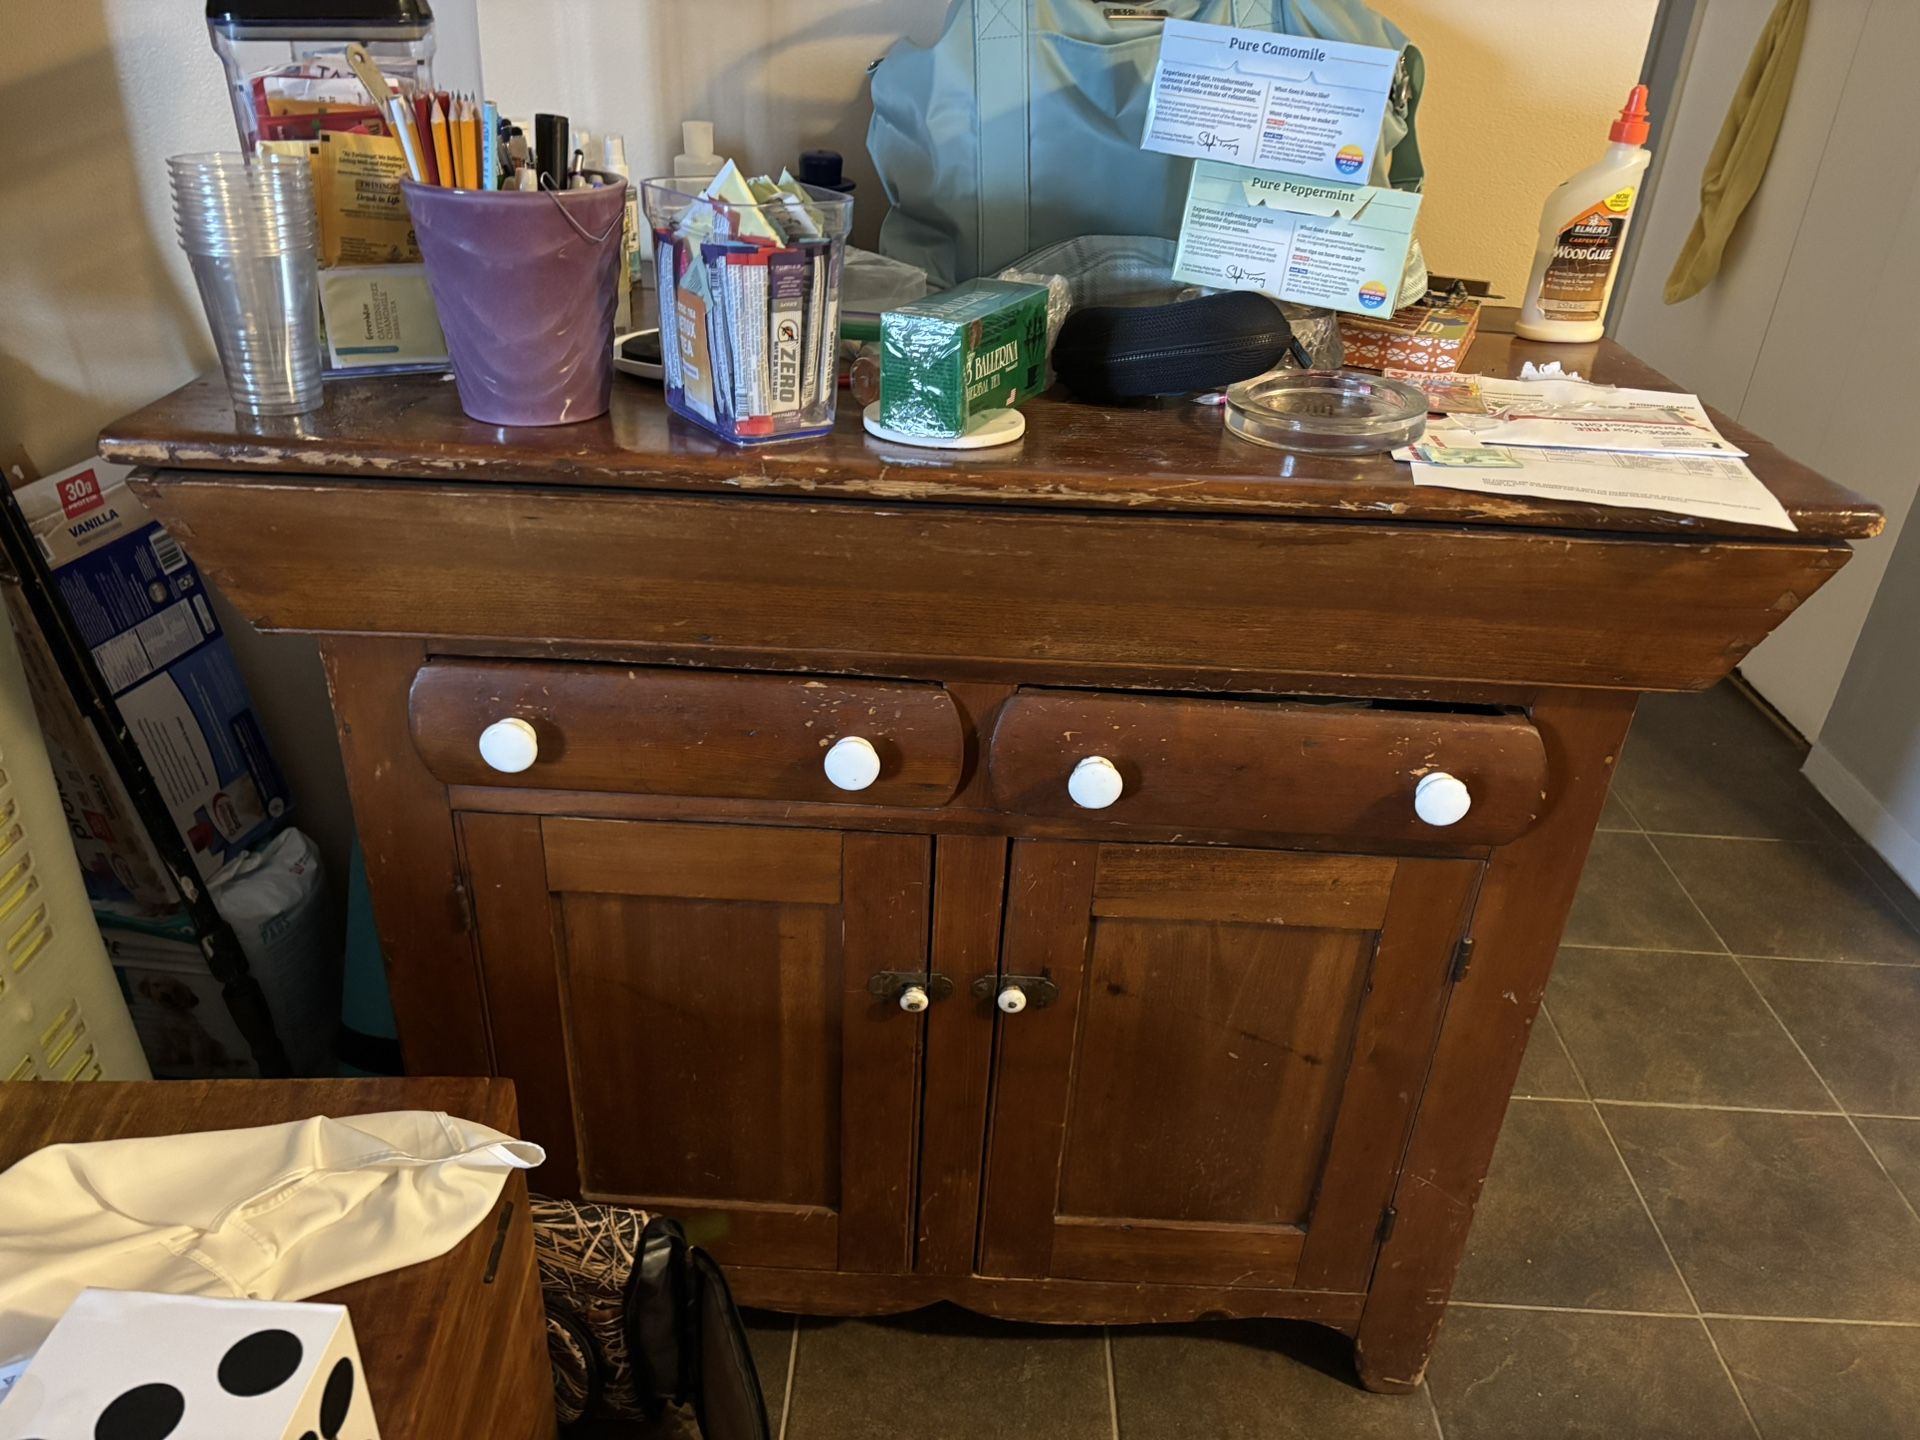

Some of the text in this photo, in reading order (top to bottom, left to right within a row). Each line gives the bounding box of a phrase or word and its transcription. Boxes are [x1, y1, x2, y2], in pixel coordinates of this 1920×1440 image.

[1229, 37, 1326, 62] Pure Camomile
[1160, 76, 1183, 85] moment
[1219, 84, 1232, 92] slow
[1246, 88, 1261, 96] mind
[1162, 68, 1191, 78] Experience
[1211, 76, 1253, 87] transformative
[1170, 84, 1182, 92] help
[1221, 91, 1228, 99] of
[1273, 85, 1287, 93] What
[1251, 177, 1355, 203] Pure Peppermint
[1191, 205, 1220, 215] Experience
[1224, 211, 1252, 221] refreshing
[1251, 215, 1262, 223] cup
[1262, 217, 1274, 225] that
[1205, 214, 1222, 223] soothe
[1222, 217, 1246, 227] digestion
[1246, 221, 1257, 229] and
[1189, 219, 1218, 229] invigorates
[1218, 224, 1231, 232] your
[975, 340, 1018, 380] BALLERINA
[780, 347, 796, 403] ZERO
[1410, 373, 1471, 383] MAGNET
[65, 479, 93, 502] 30g
[68, 509, 119, 538] VANILLA
